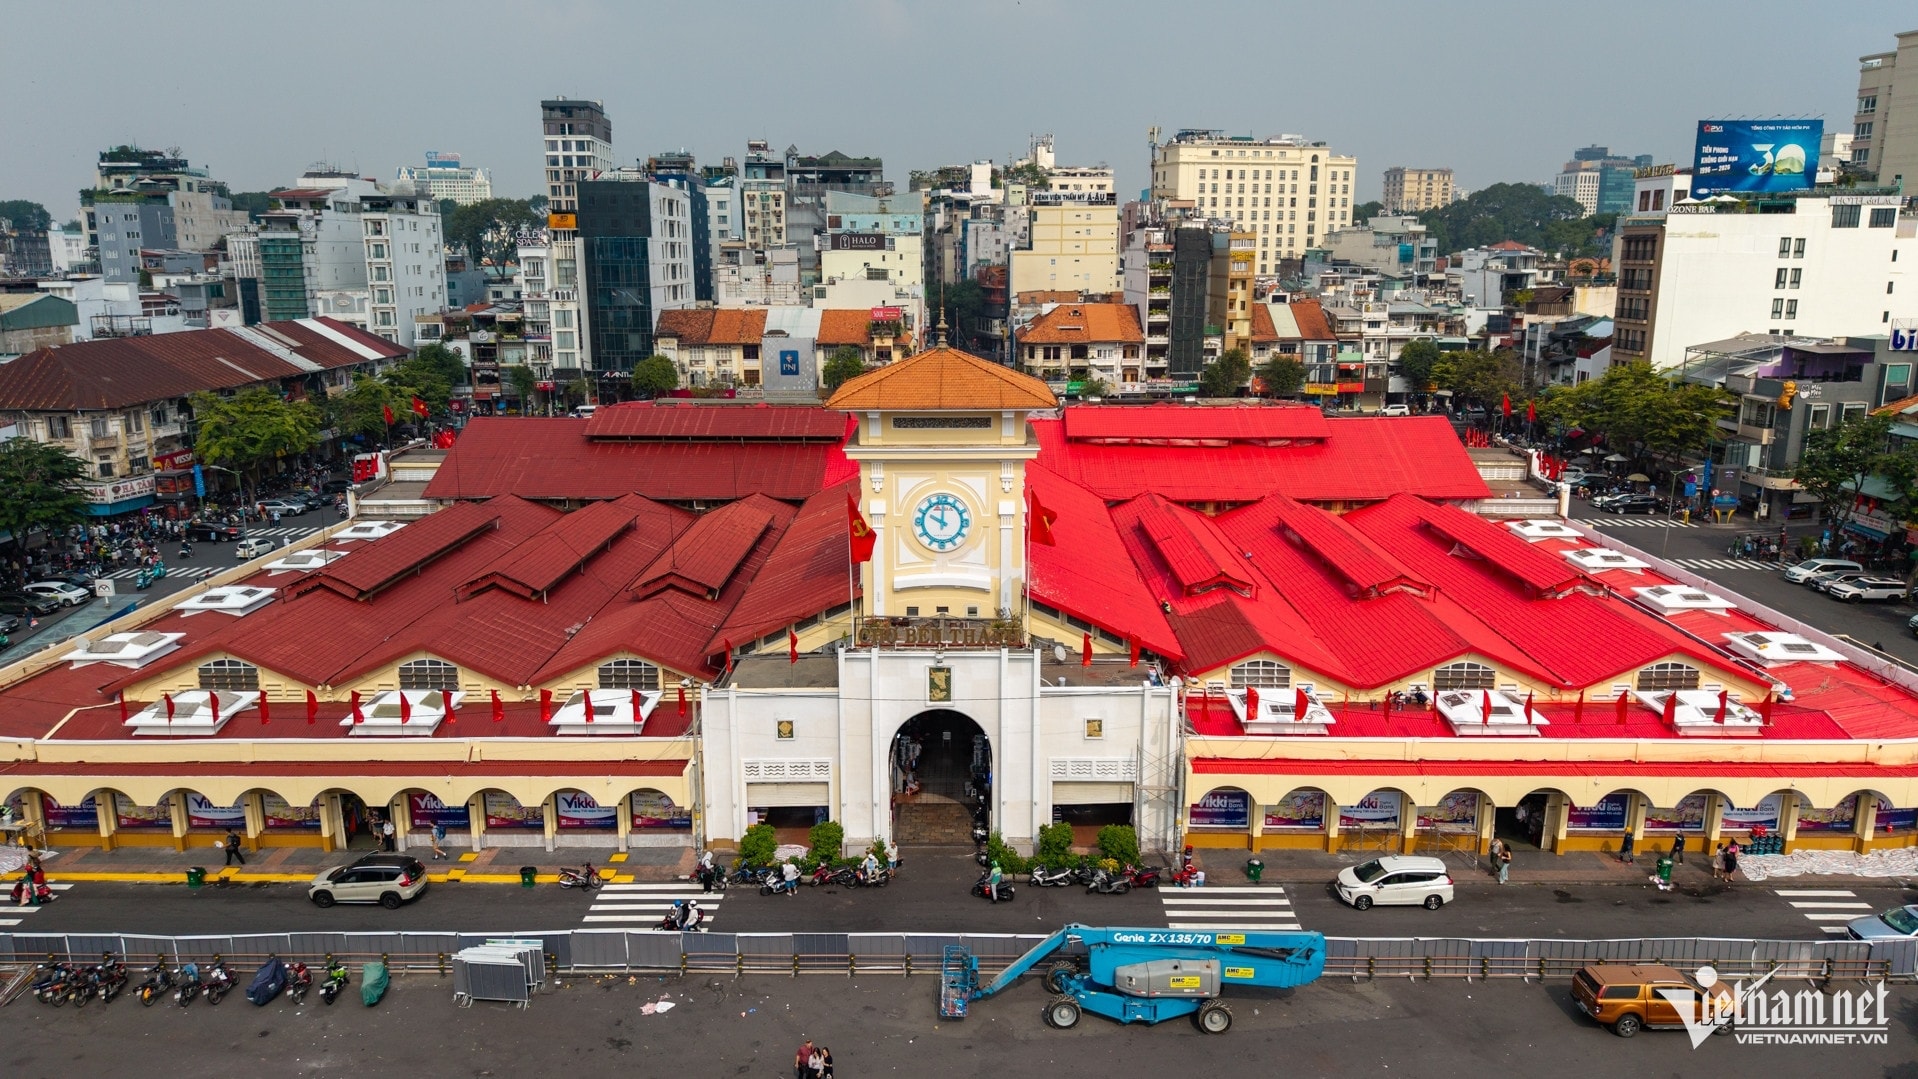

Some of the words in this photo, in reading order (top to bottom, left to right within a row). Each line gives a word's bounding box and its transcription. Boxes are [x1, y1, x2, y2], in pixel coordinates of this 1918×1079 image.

[1667, 205, 1696, 213] OZONE
[1698, 205, 1715, 213] BAR
[516, 239, 532, 247] SPA
[851, 236, 876, 244] HALO
[783, 363, 797, 372] PNJ
[859, 626, 899, 644] CHỢ
[904, 622, 943, 644] BẾN
[1114, 932, 1145, 943] Genie
